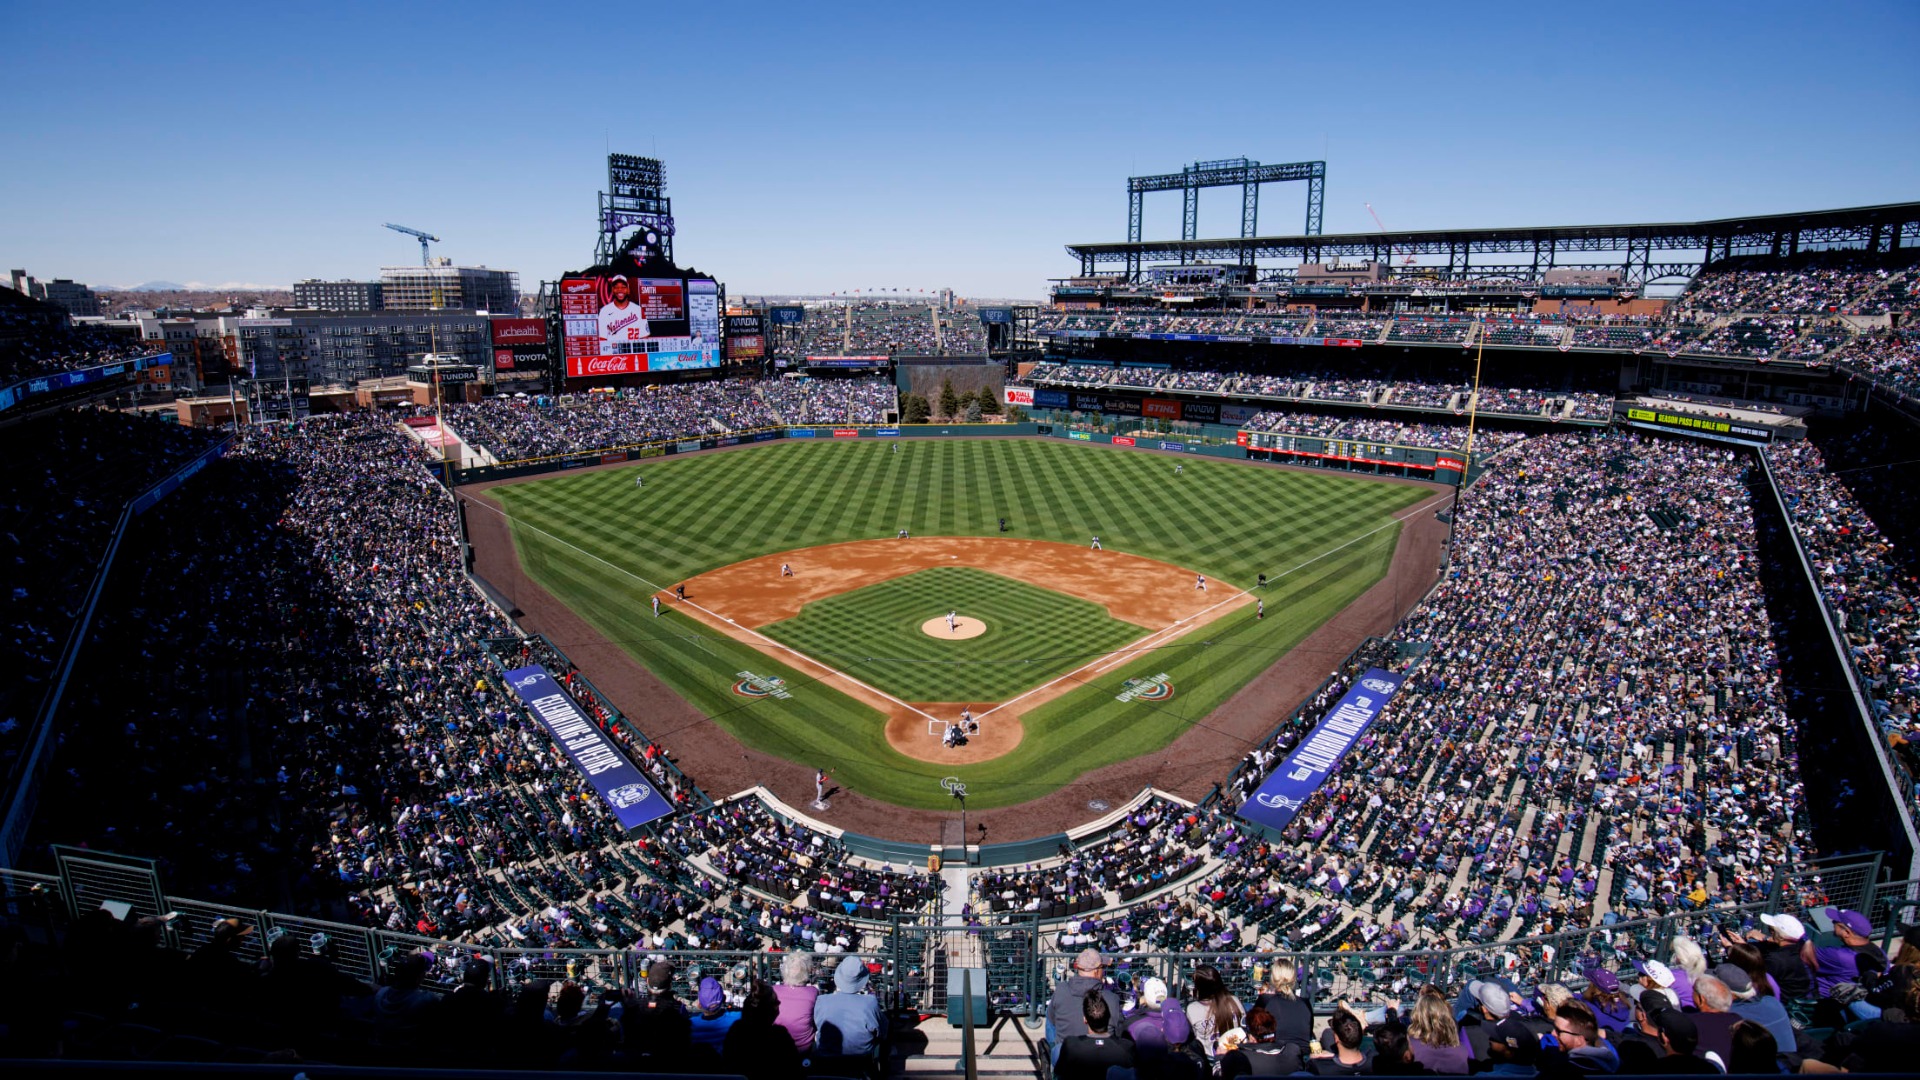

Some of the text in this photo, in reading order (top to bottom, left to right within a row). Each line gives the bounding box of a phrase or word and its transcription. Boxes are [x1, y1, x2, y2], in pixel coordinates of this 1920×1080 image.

[604, 212, 676, 236] ROCKIES
[641, 286, 656, 294] SMITH
[780, 310, 797, 320] tgrp
[986, 310, 1003, 320] tgrp
[607, 311, 638, 334] Nationals
[499, 325, 539, 336] uchealth
[627, 327, 640, 340] 22
[733, 338, 758, 347] KING
[514, 353, 547, 362] TOYOTA
[677, 353, 698, 362] Chill
[441, 371, 475, 381] TUNDRA
[1076, 395, 1091, 403] Bank
[1076, 402, 1103, 411] Colorado
[1147, 404, 1176, 414] STIHL
[1658, 413, 1679, 425] SEASON
[1678, 417, 1693, 427] PASS
[1693, 419, 1702, 428] ON
[1702, 420, 1716, 430] SALE
[1716, 422, 1731, 433] NOW
[531, 693, 624, 776] CELEBRATING 30 YEARS
[1292, 702, 1374, 773] COLORADO ROCKIES
